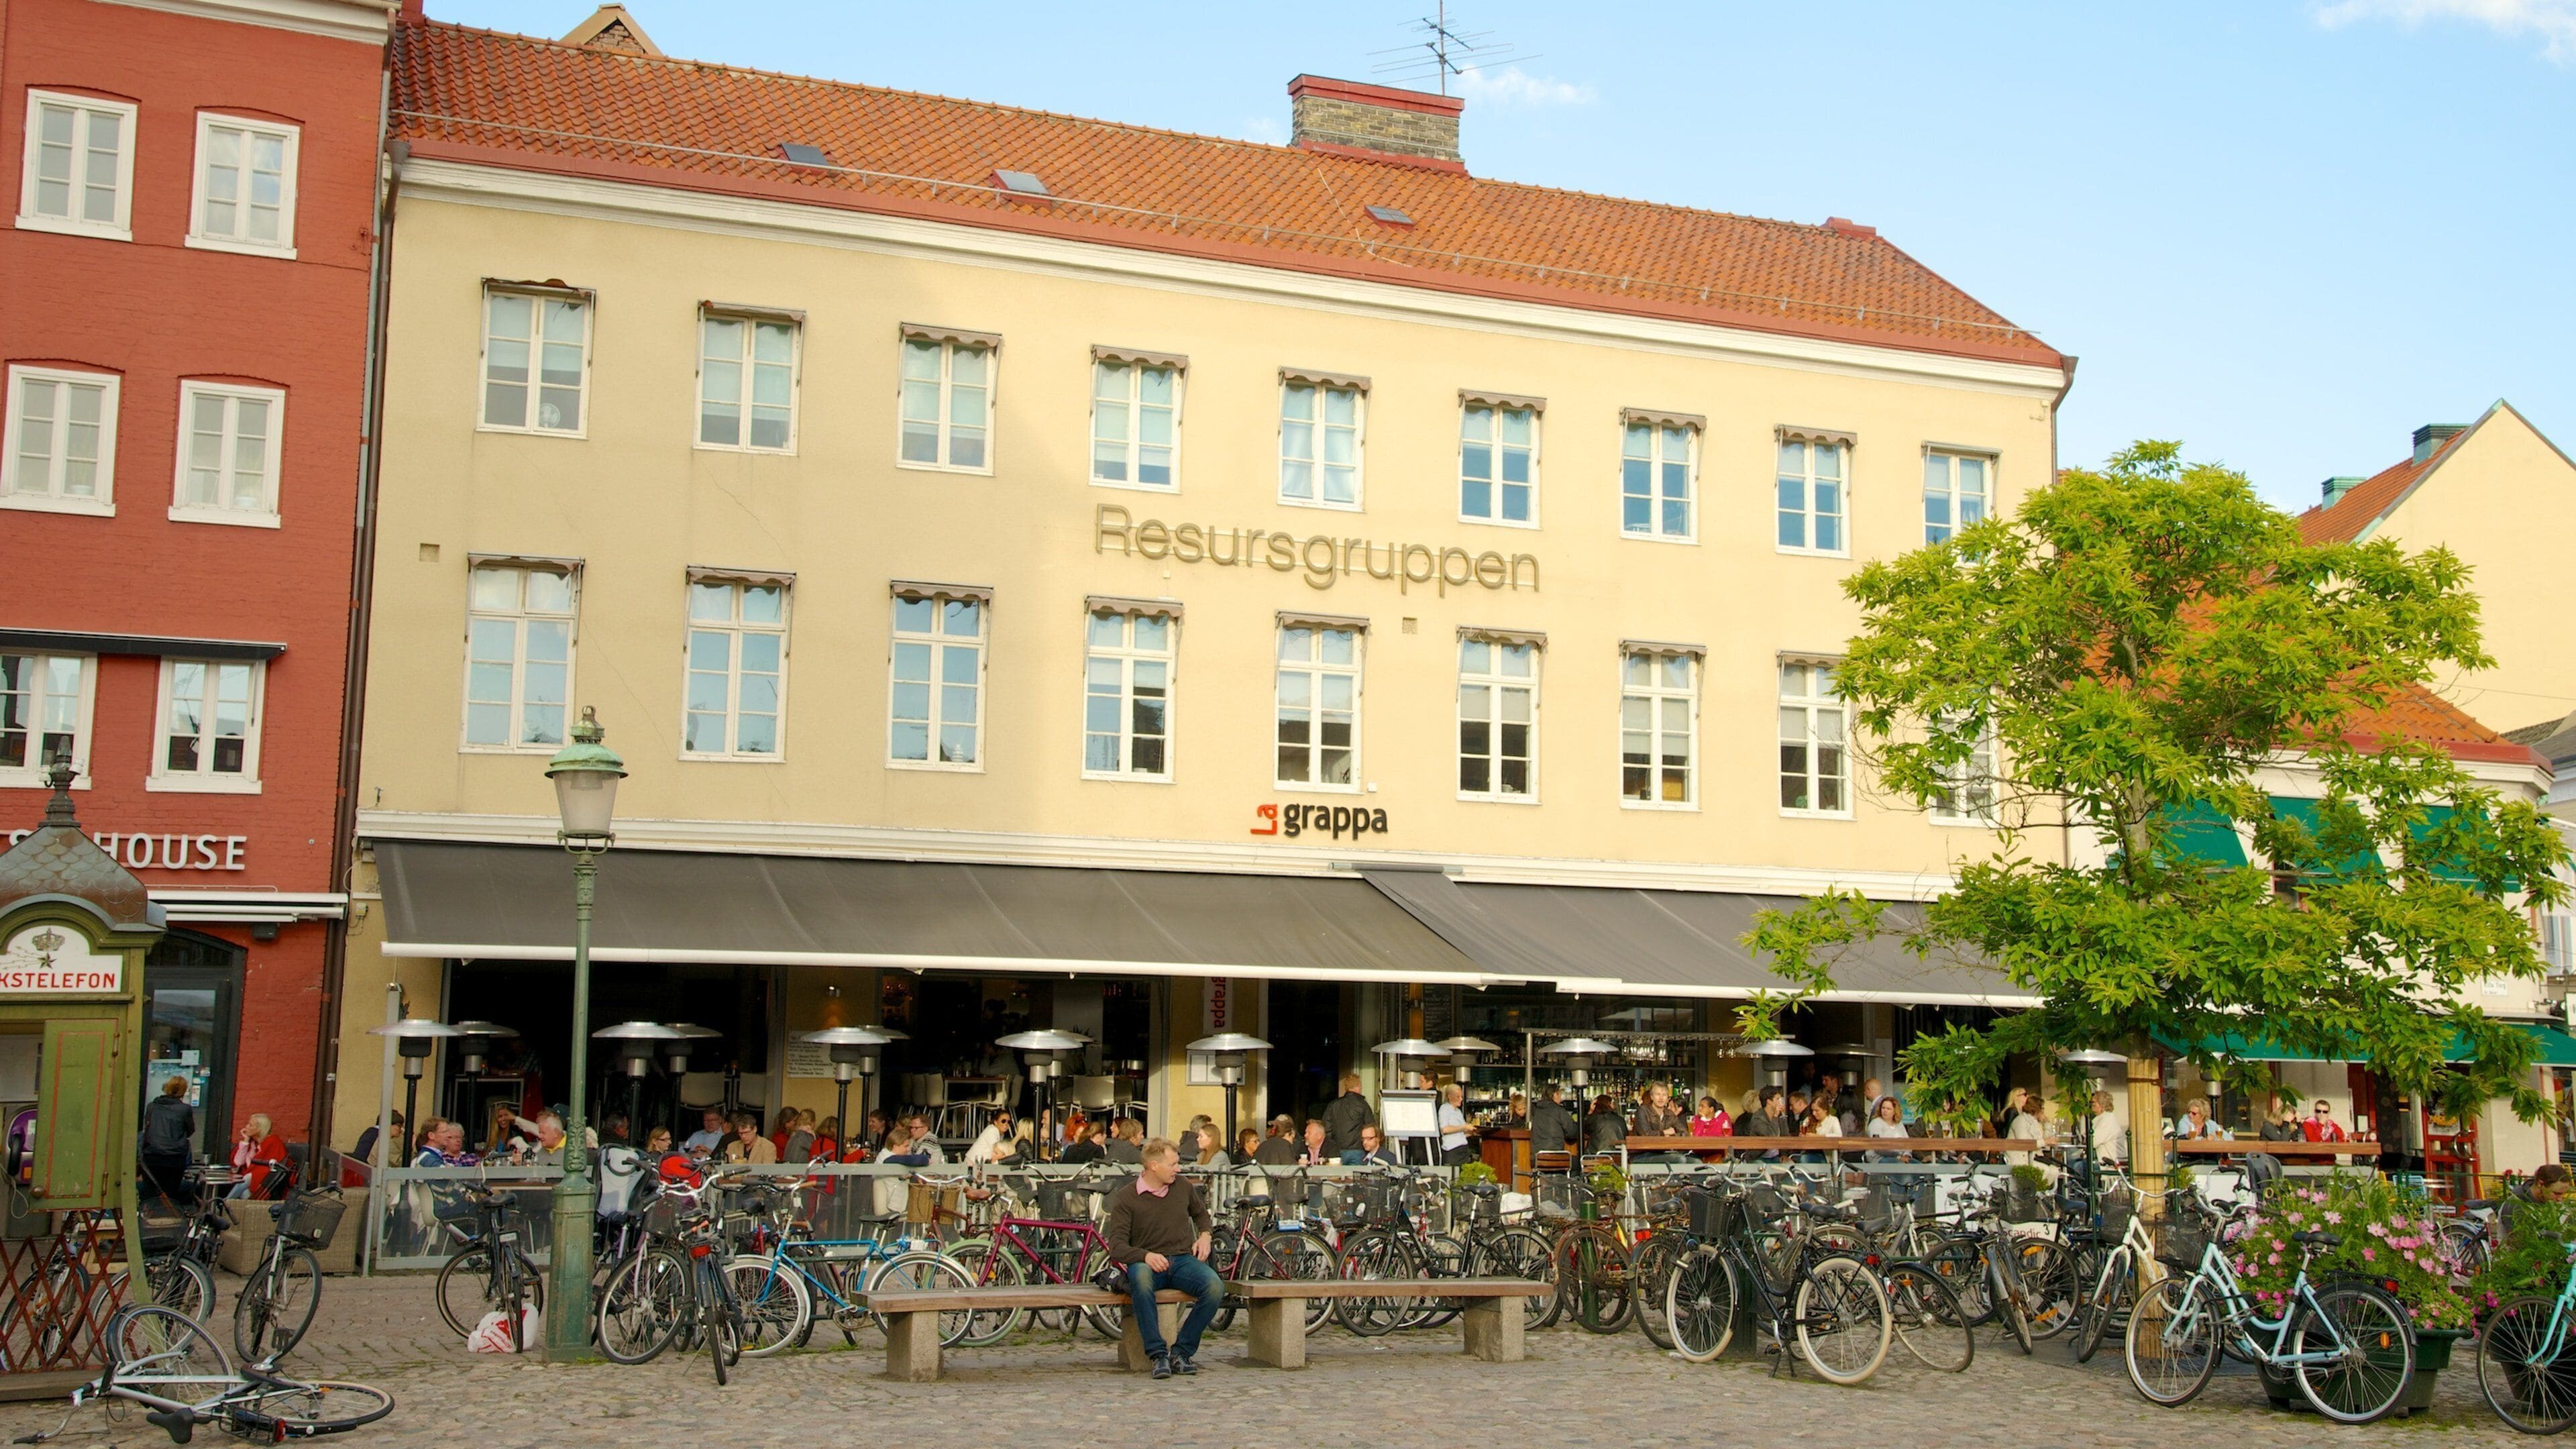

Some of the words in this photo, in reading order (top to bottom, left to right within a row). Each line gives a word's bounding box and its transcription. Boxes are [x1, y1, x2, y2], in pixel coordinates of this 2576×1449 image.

[1096, 503, 1540, 597] Resursgruppen
[1250, 804, 1278, 835] La
[1284, 803, 1388, 840] grappa
[94, 832, 247, 870] HOUSE
[0, 973, 115, 987] KSTELEFON
